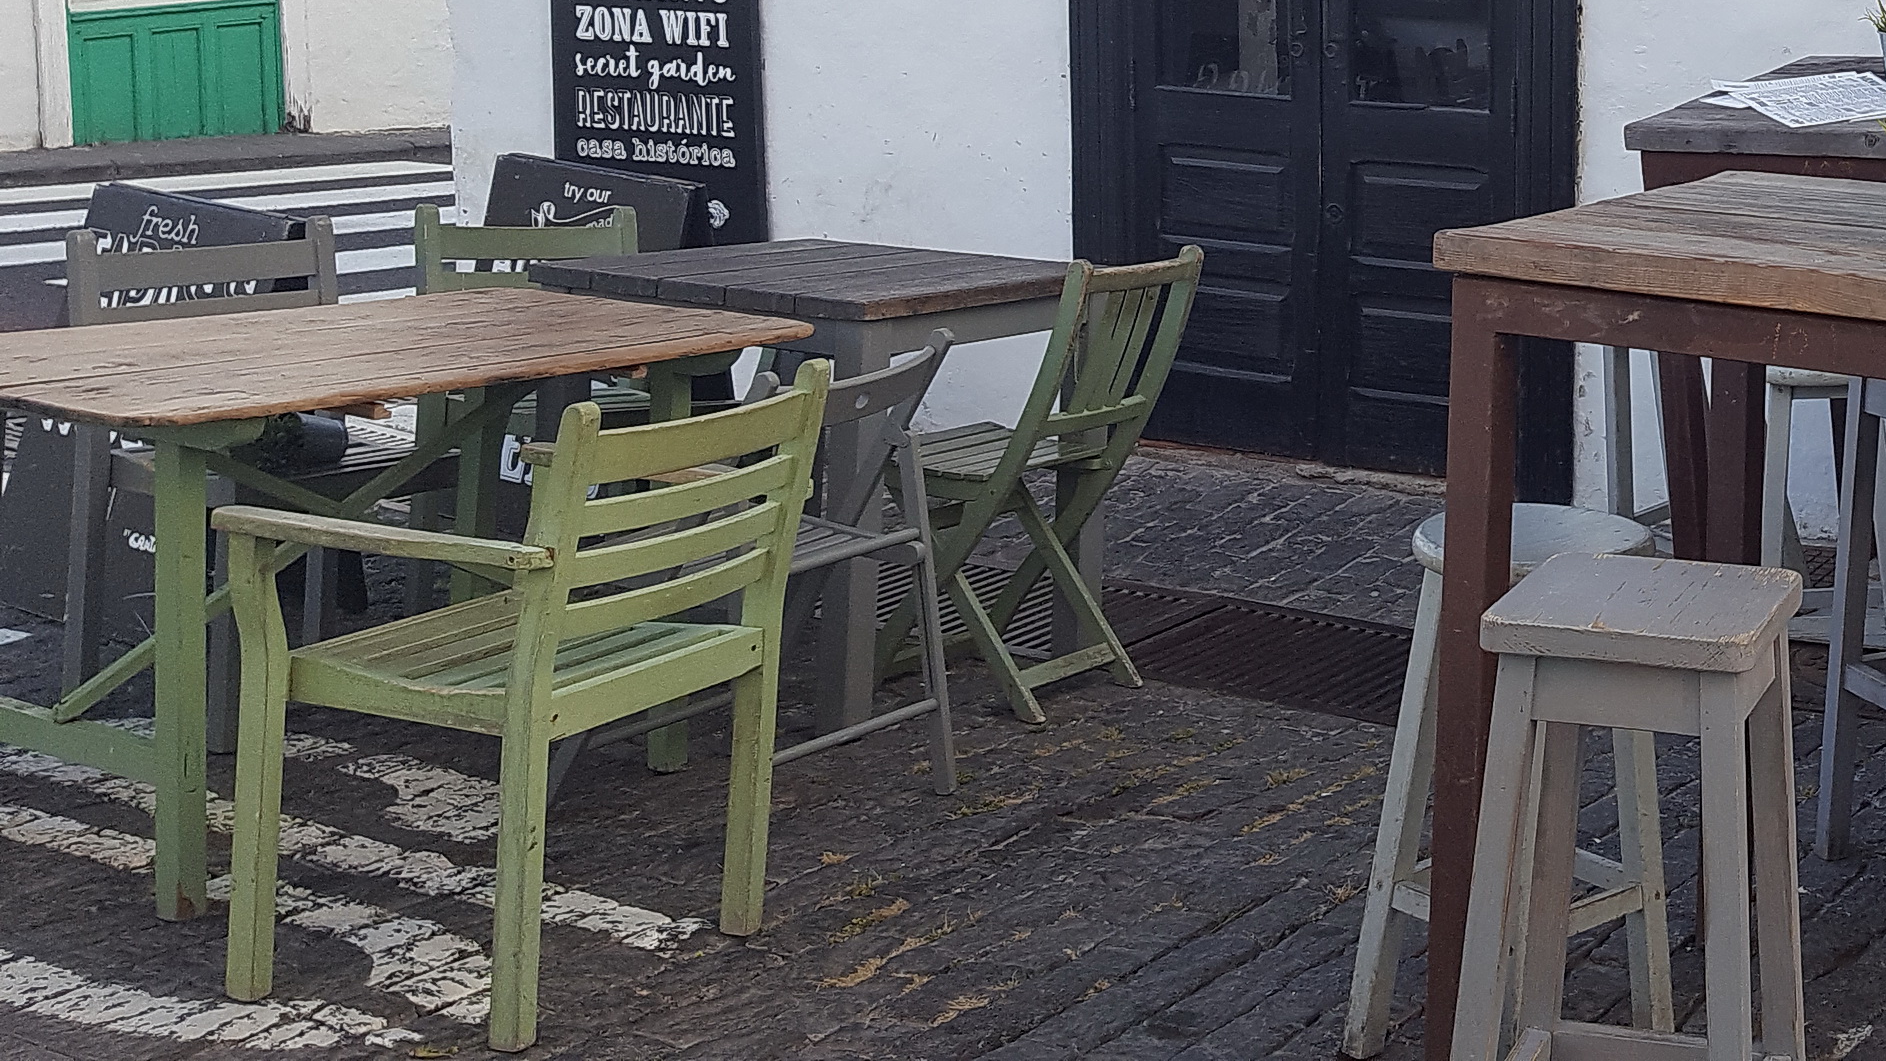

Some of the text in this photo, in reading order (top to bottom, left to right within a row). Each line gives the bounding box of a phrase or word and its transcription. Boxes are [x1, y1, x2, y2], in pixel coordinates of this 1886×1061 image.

[575, 5, 730, 48] ZONA WIFI
[575, 44, 736, 90] secret garden
[575, 87, 735, 138] RESTAURANTE
[576, 138, 736, 168] casa histórica
[564, 181, 612, 203] try our
[129, 205, 200, 244] fresh
